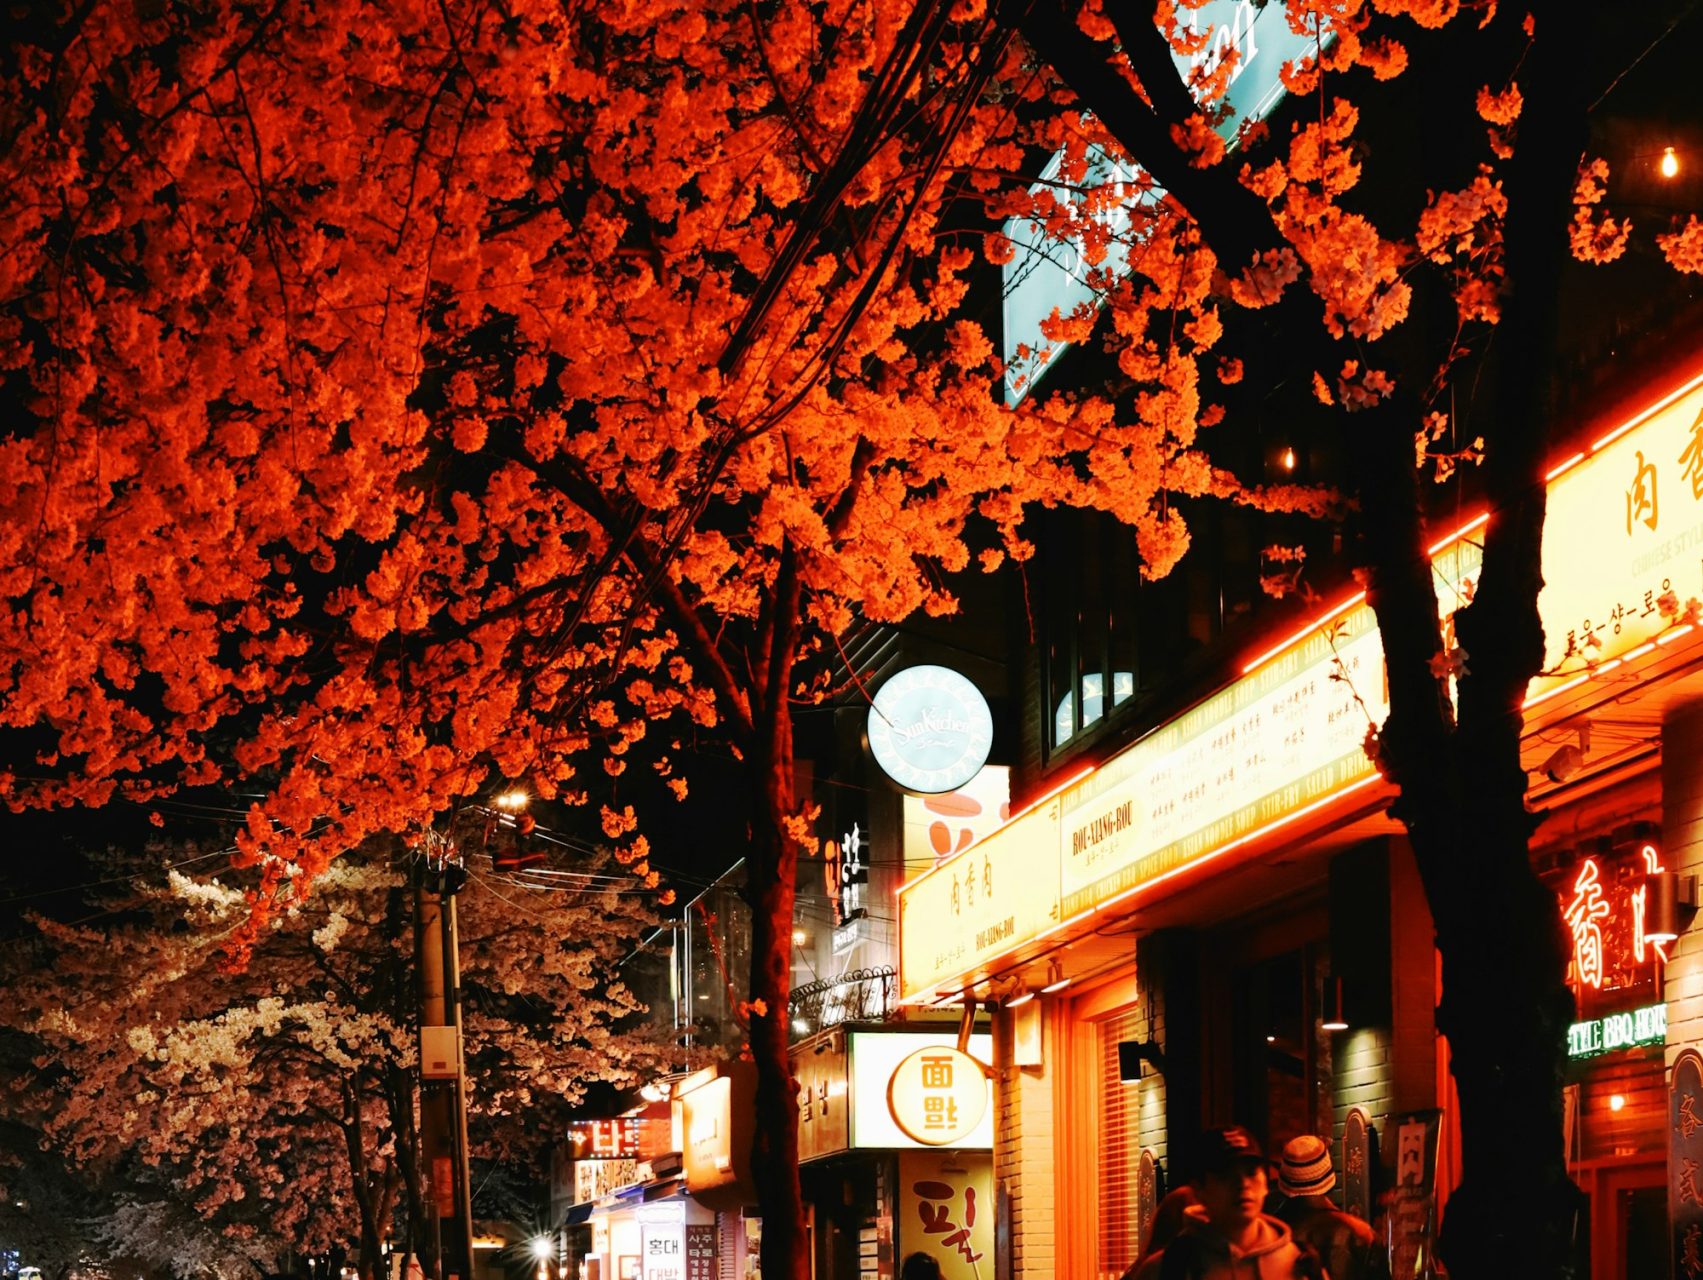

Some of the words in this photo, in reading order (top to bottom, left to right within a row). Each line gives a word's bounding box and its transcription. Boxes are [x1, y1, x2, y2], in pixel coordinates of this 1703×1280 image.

[1674, 521, 1703, 557] STYL
[1236, 805, 1256, 834] SOUP
[1262, 784, 1299, 821] STIR-FRY
[1306, 766, 1334, 799] SALAD
[1603, 1013, 1635, 1049] BBQ
[649, 1239, 679, 1256] 홍대
[689, 1234, 712, 1244] 사주
[689, 1249, 713, 1258] 타로
